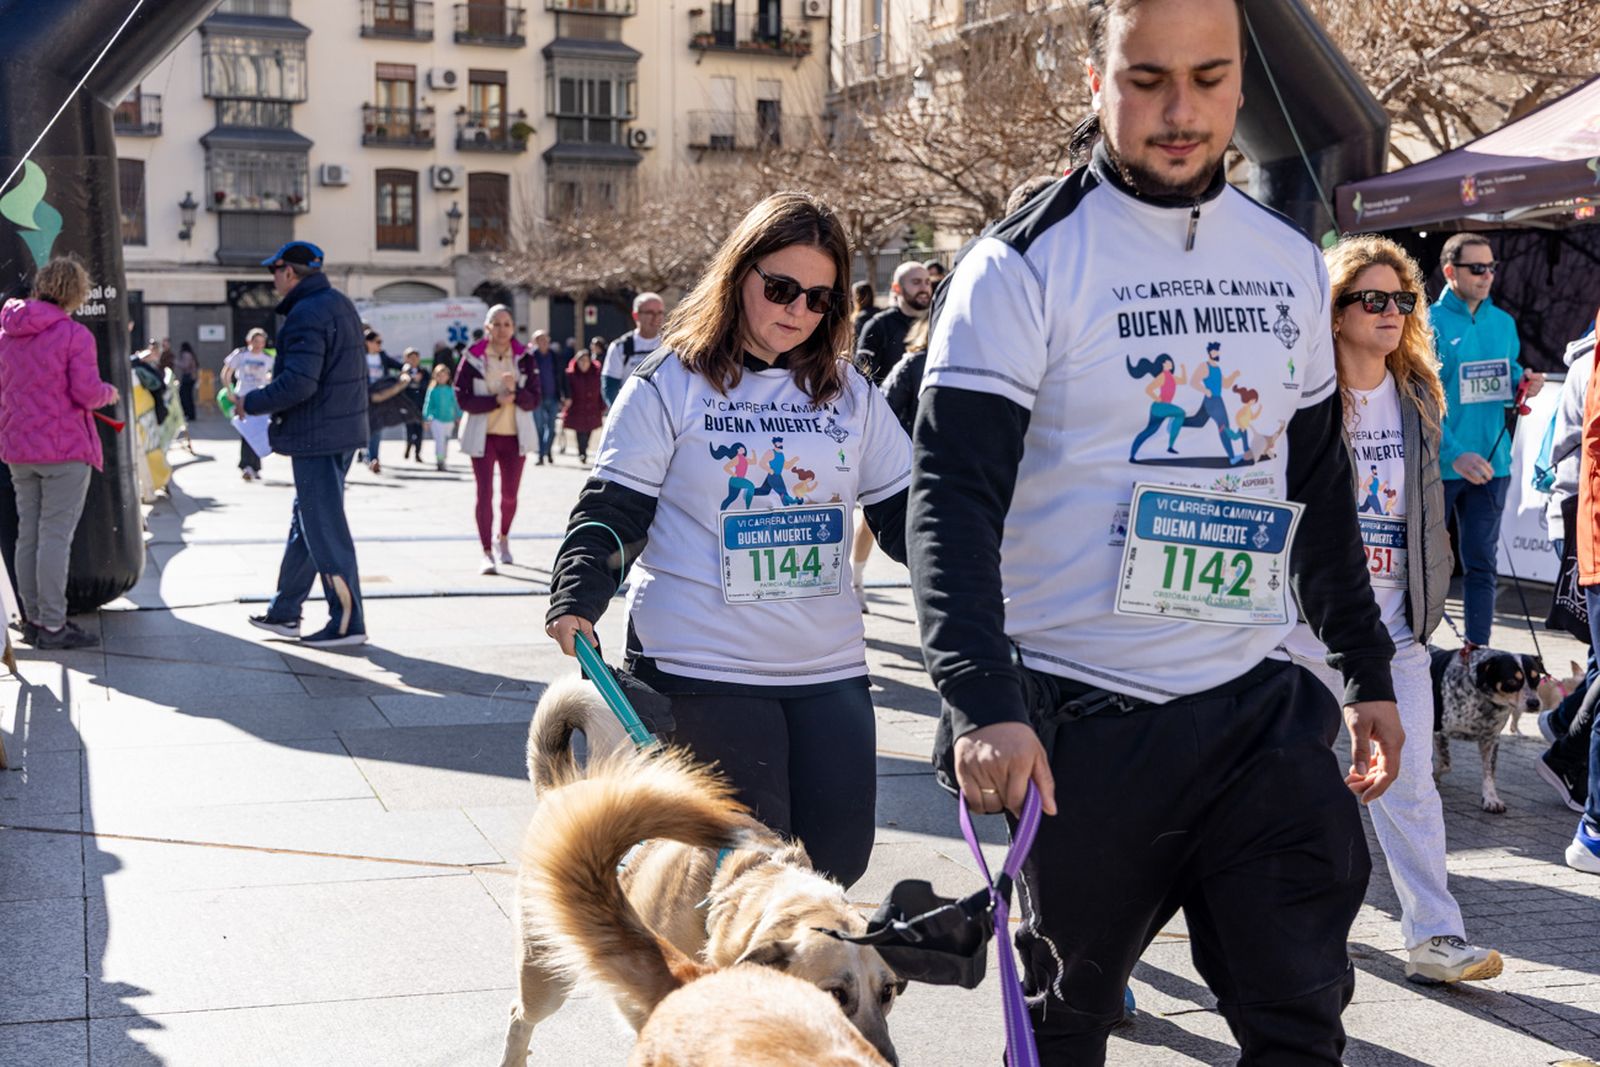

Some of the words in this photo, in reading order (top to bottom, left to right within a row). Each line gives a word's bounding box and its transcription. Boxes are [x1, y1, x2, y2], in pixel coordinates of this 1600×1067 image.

[85, 285, 102, 300] pal
[103, 285, 117, 299] de
[1112, 287, 1131, 302] VI
[1135, 278, 1216, 299] CARRERA
[1219, 279, 1296, 298] CAMINATA
[76, 301, 106, 316] Jaén
[1117, 308, 1188, 338] BUENA
[1195, 306, 1270, 334] MUERTE
[1470, 377, 1501, 393] 1130
[702, 398, 716, 410] VI
[718, 400, 778, 414] CARRERA
[704, 414, 757, 433] BUENA
[760, 416, 823, 433] MUERTE
[1350, 430, 1372, 441] RERA
[1373, 429, 1404, 441] CAMIN
[1362, 444, 1405, 461] MUERTE
[1156, 498, 1168, 511] VI
[1170, 501, 1220, 517] CARRERA
[1222, 506, 1275, 523] CAMINATA
[736, 520, 747, 528] VI
[749, 516, 786, 528] CARRERA
[788, 513, 831, 524] CAMINATA
[737, 531, 771, 545] BUENA
[773, 527, 813, 543] MUERTE
[1152, 516, 1196, 539] BUENA
[1199, 522, 1248, 545] MUERTE
[1513, 536, 1553, 553] CIUDAD
[748, 546, 822, 582] 1144
[1161, 544, 1253, 597] 1142
